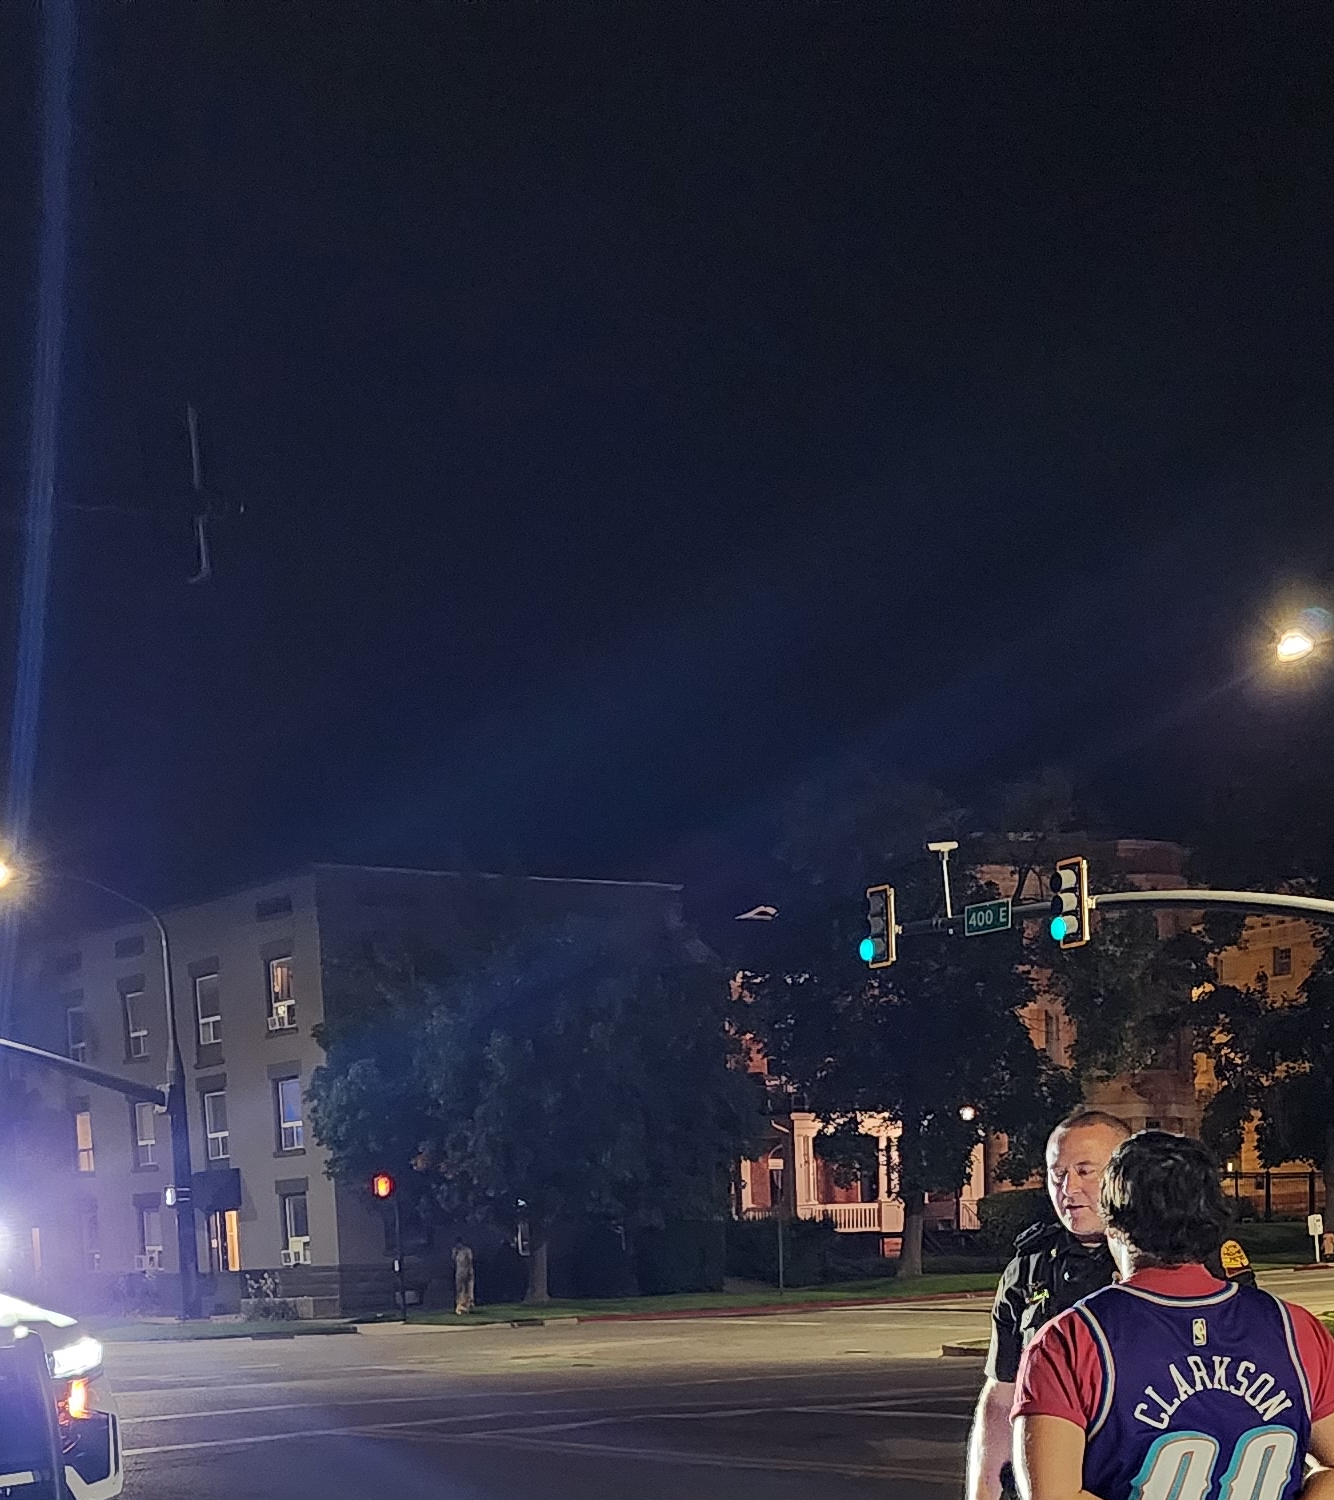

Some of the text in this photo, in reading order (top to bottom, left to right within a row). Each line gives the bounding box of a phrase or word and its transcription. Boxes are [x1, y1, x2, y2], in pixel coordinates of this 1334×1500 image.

[968, 906, 1007, 928] 400 E
[1134, 1355, 1292, 1430] CLARKSON
